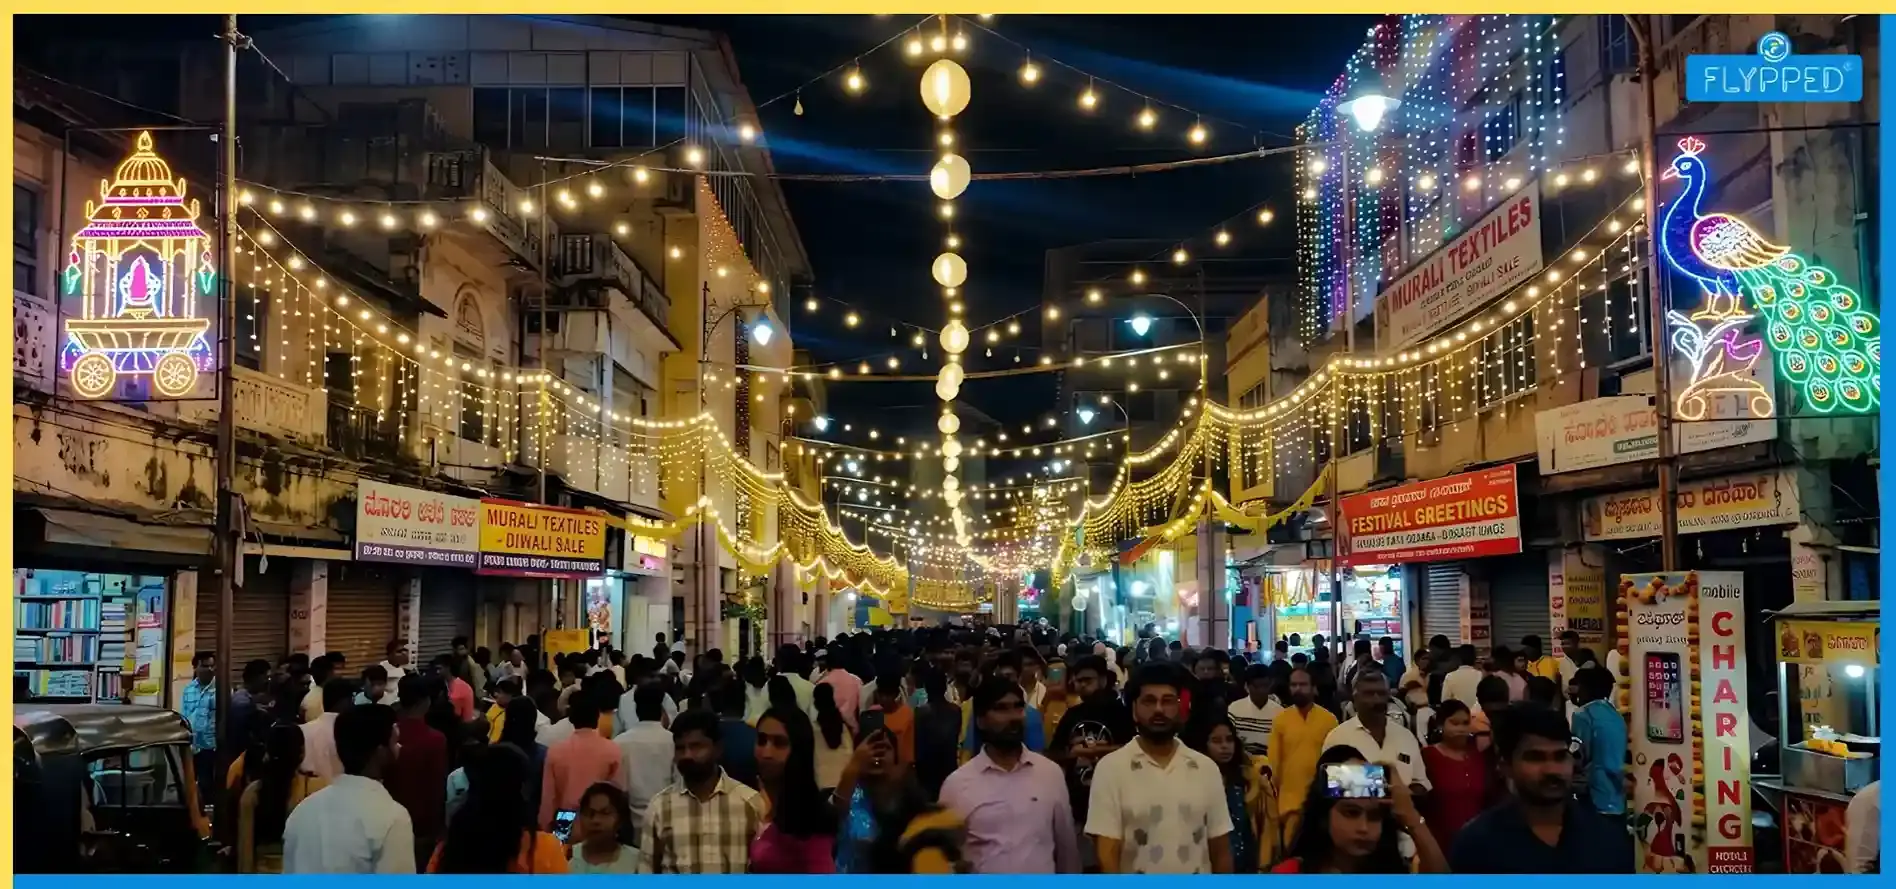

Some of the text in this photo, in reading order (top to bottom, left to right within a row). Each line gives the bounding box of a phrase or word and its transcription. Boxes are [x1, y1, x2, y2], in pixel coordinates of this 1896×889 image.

[1391, 255, 1445, 313] MURALI
[1448, 195, 1532, 275] TEXTILES
[487, 509, 600, 537] MURALI TEXTILES
[1351, 494, 1509, 534] FESTIVAL GREETINGS
[555, 536, 585, 554] SALE
[1711, 610, 1742, 840] CHARING
